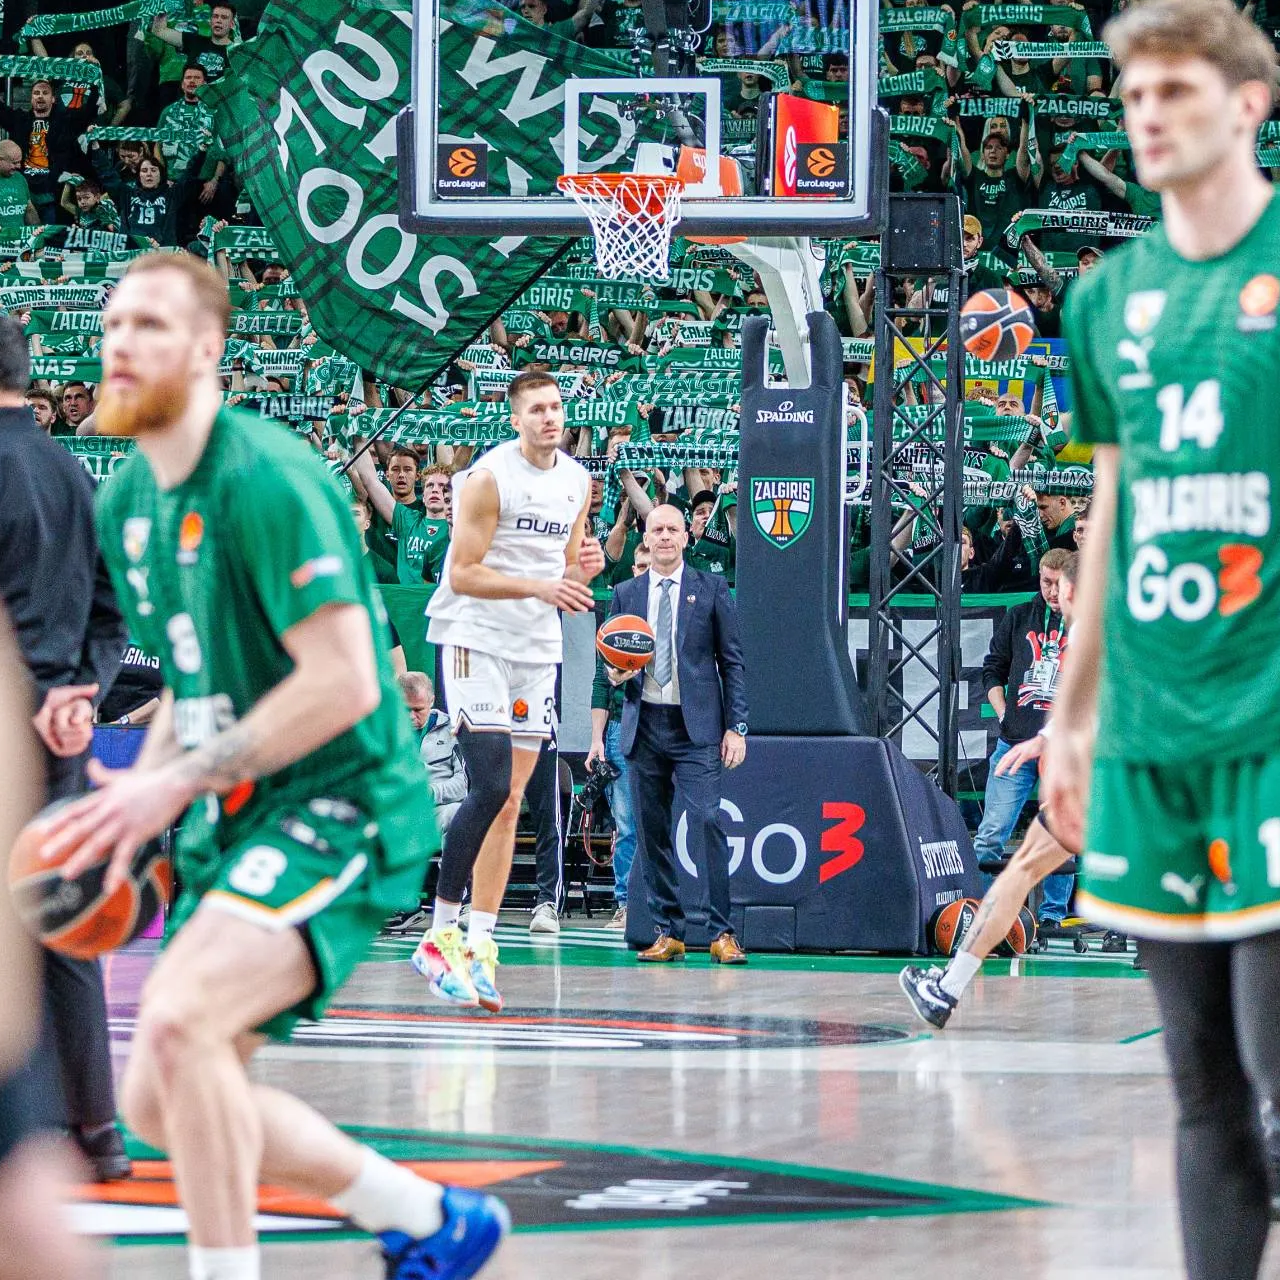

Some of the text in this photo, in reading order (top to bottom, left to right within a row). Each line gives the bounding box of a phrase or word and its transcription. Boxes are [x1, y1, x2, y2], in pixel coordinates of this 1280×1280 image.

[438, 178, 487, 190] EuroLeague
[797, 178, 846, 190] EuroLeague
[138, 208, 155, 224] 19
[756, 410, 814, 424] SPALDING
[1156, 380, 1224, 453] 14
[1050, 471, 1095, 487] BOYS
[517, 518, 569, 535] DUBA
[1127, 543, 1263, 622] Go3
[120, 647, 160, 668] LGIRIS
